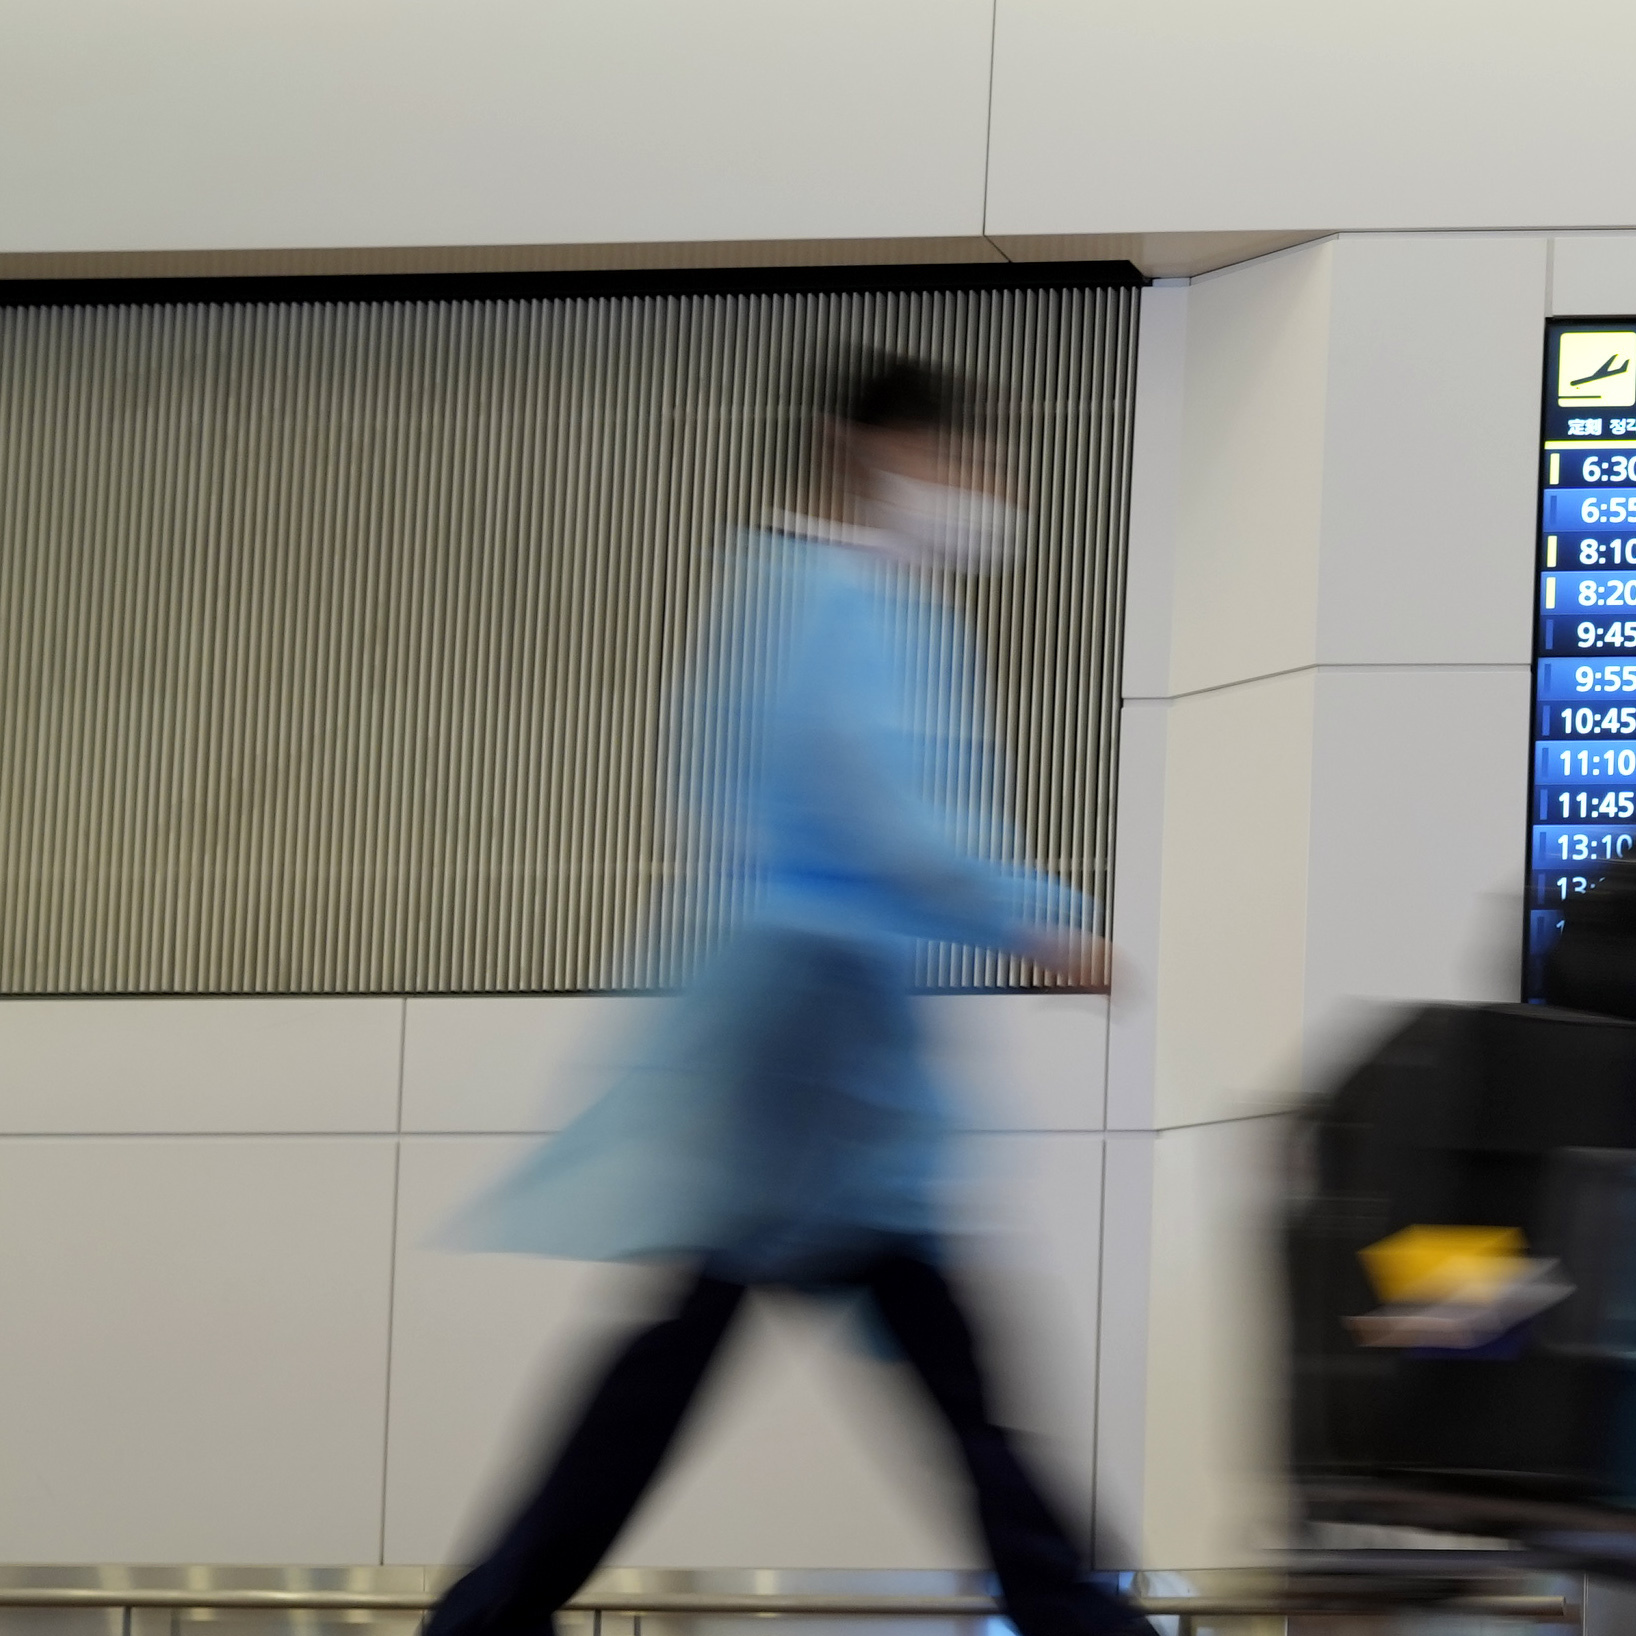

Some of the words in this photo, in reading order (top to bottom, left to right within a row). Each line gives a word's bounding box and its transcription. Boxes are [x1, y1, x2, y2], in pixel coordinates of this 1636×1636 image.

[1562, 708, 1636, 734] 10:45
[1560, 750, 1635, 775] 11:10
[1559, 792, 1634, 817] 11:45
